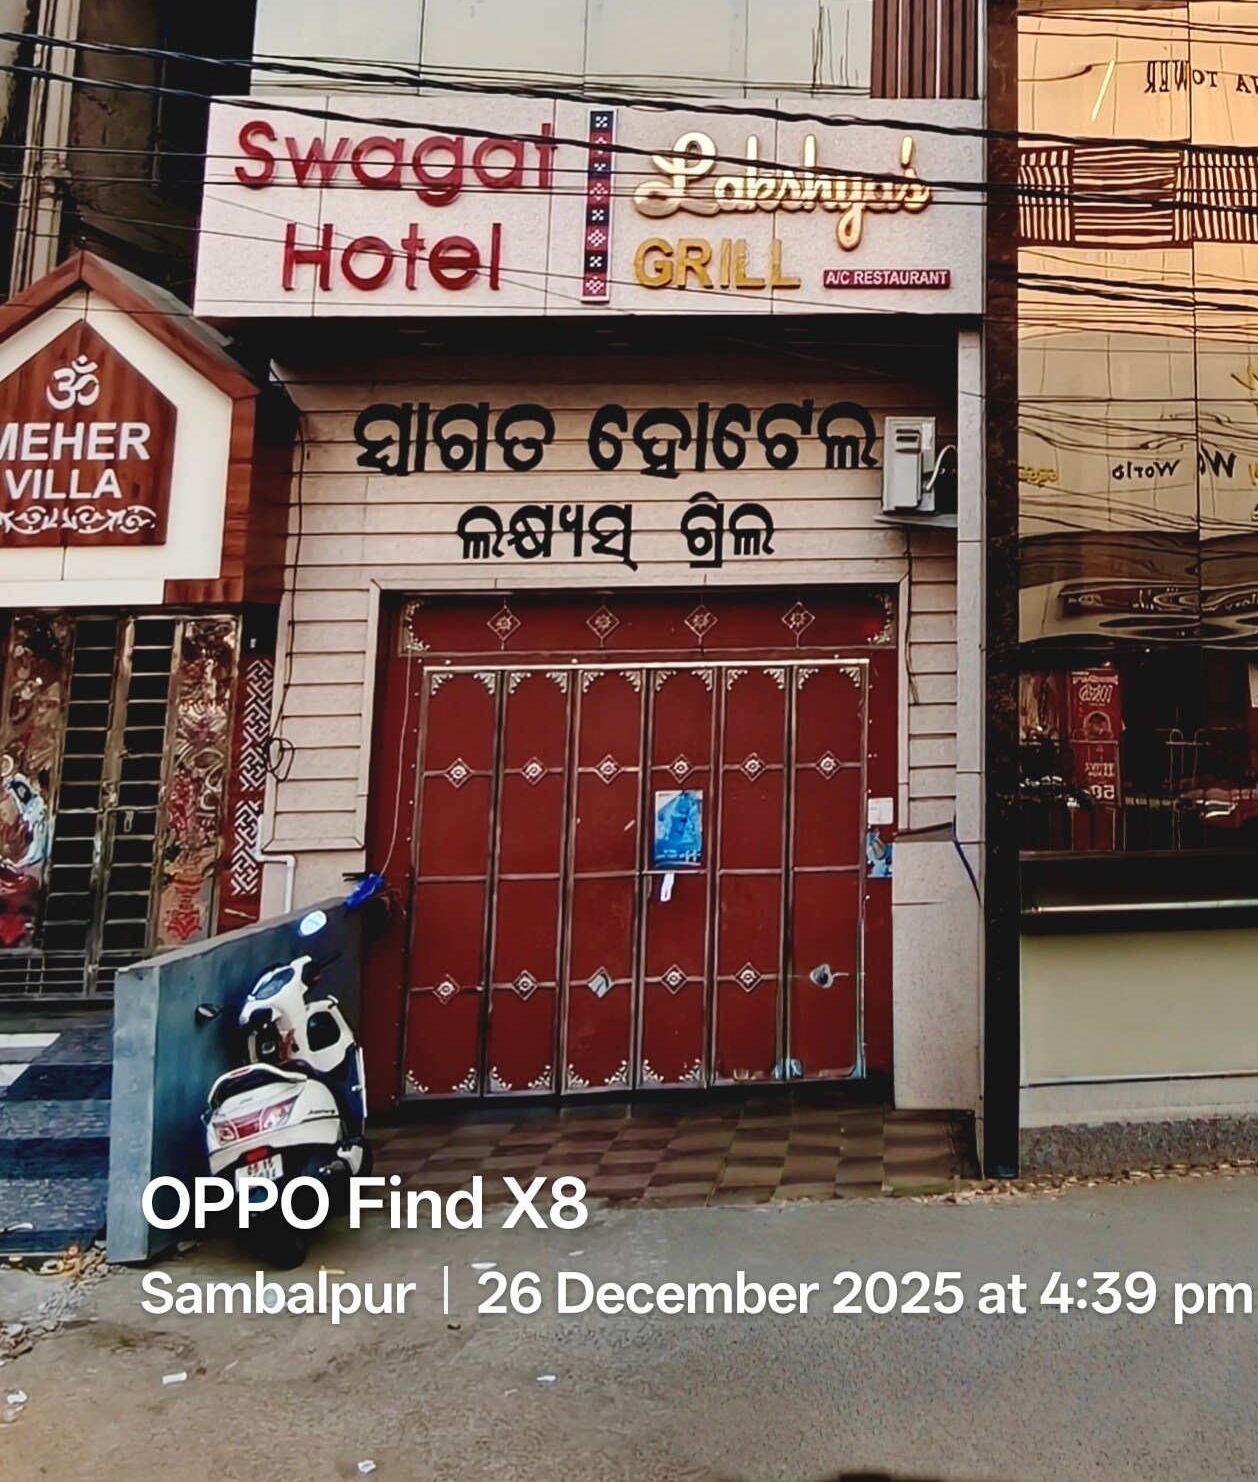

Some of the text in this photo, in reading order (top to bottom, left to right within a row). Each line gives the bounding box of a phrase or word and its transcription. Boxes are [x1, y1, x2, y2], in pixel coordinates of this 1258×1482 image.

[234, 120, 557, 208] Swagat
[631, 130, 932, 252] Lakshya's
[282, 221, 503, 293] Hotel
[632, 237, 802, 291] GRILL
[825, 270, 948, 285] A/C RESTAURANT
[5, 469, 123, 500] VILLA
